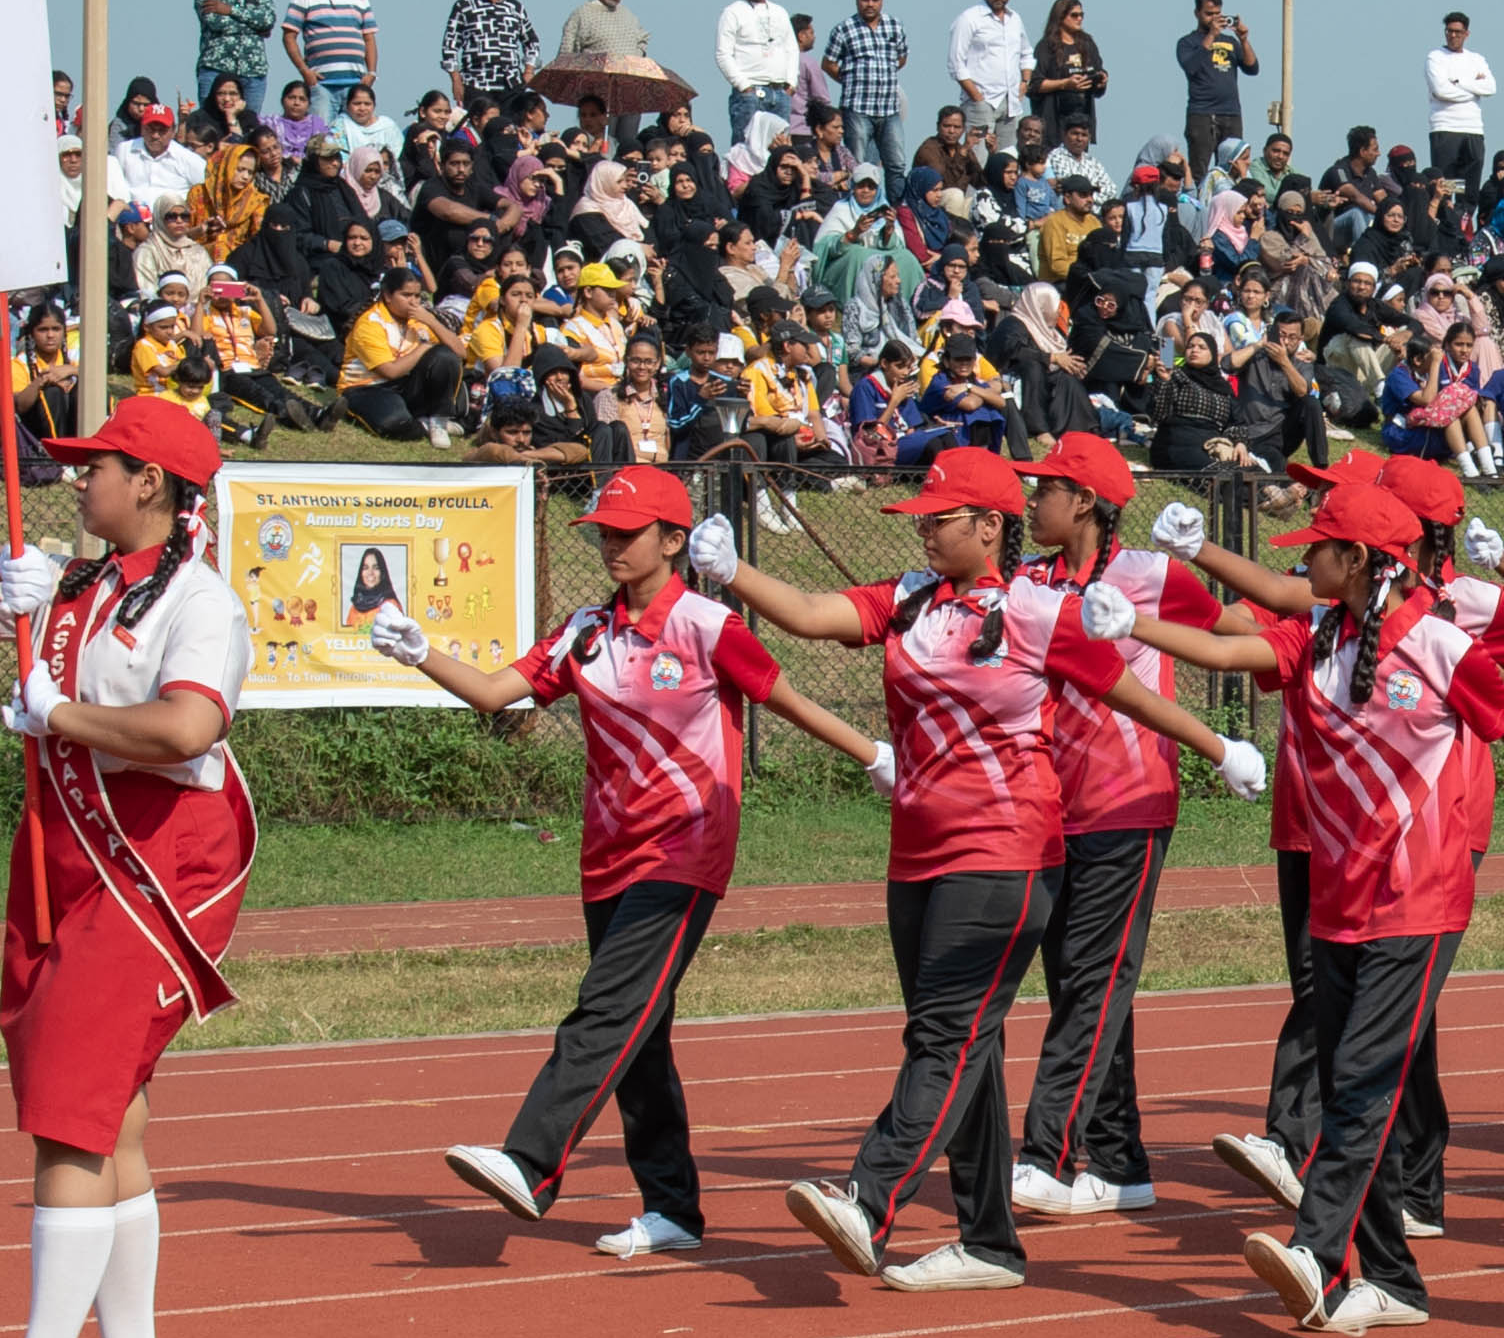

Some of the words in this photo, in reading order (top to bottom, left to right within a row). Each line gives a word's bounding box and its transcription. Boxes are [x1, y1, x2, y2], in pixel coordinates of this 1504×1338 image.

[257, 494, 277, 506] ST.
[282, 495, 361, 507] ANTHONY'S
[365, 497, 424, 510] SCHOOL,
[427, 497, 494, 509] BYCULLA.
[306, 513, 357, 527] Annual
[362, 513, 411, 531] Sports
[416, 514, 444, 531] Day
[56, 736, 162, 903] CAPTAIN
